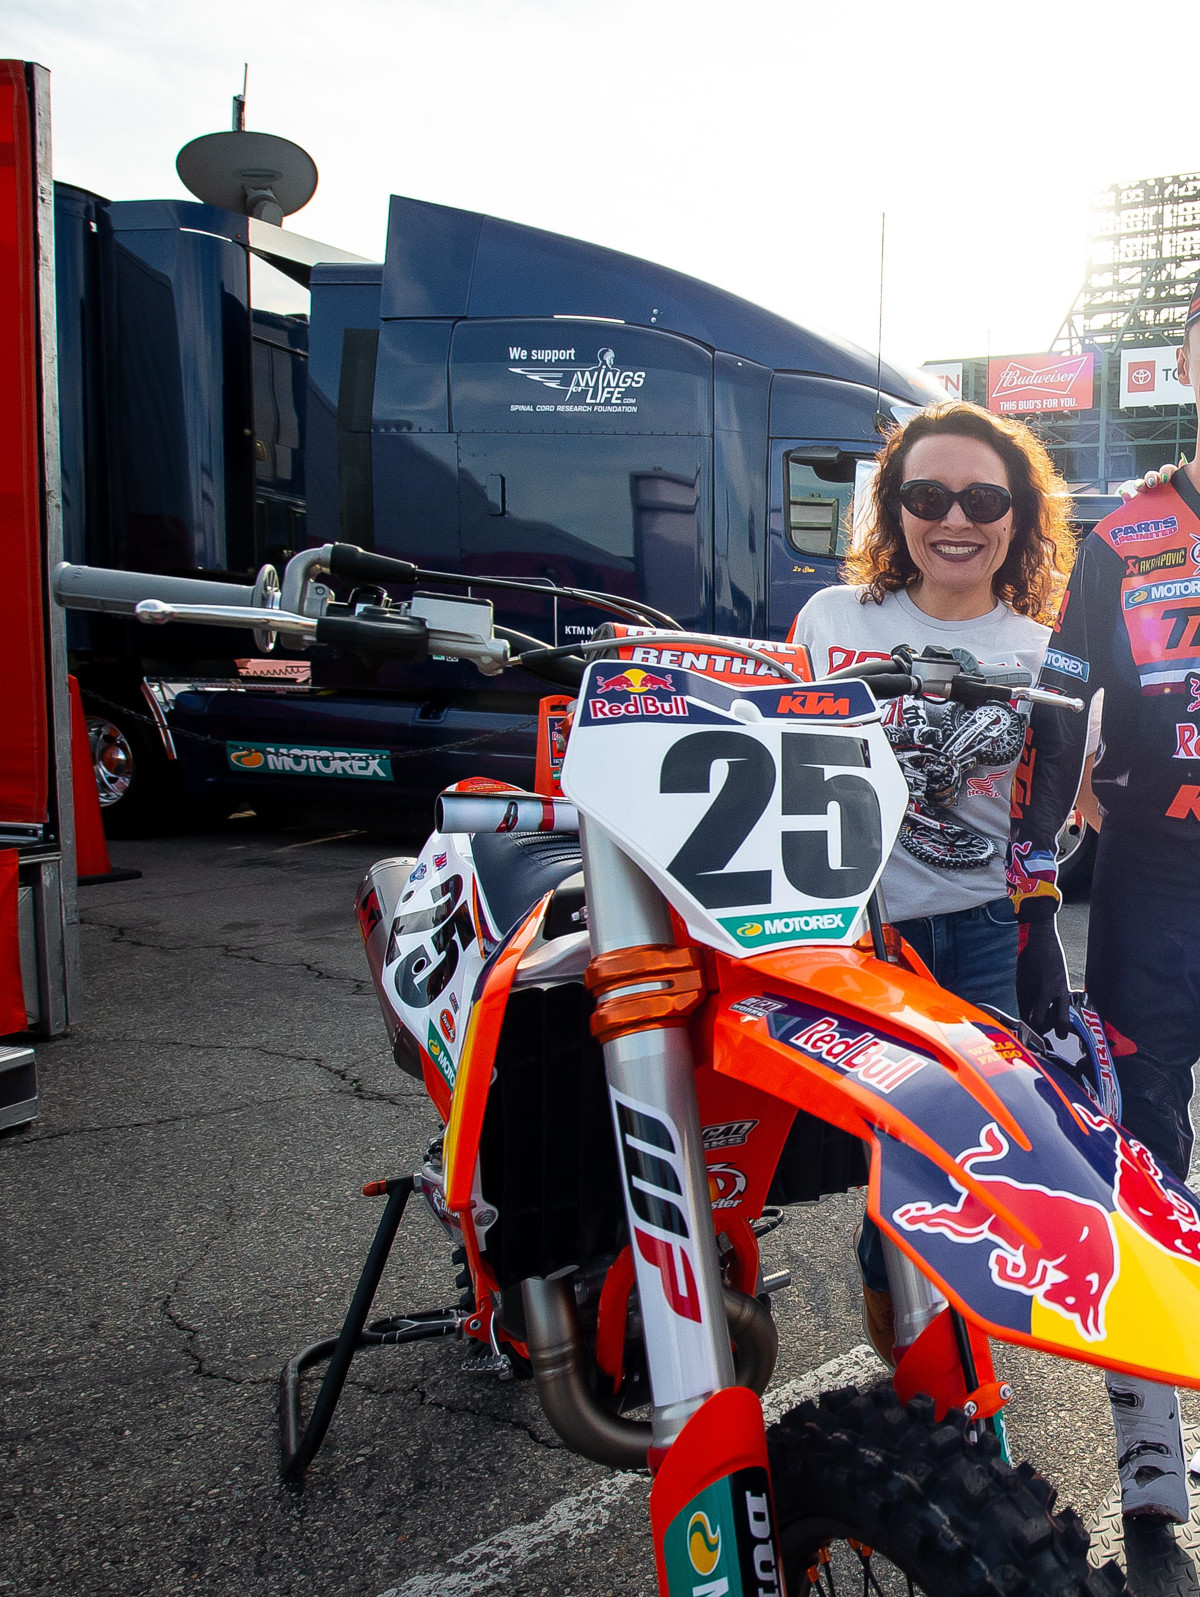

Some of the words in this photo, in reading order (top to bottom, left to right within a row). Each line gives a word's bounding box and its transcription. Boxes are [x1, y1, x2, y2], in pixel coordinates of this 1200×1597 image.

[509, 347, 527, 360] We
[531, 347, 575, 362] support
[575, 366, 646, 388] WINGS
[1000, 370, 1078, 388] Budweiser
[594, 405, 638, 413] FOUNDATION
[1000, 401, 1017, 411] THIS
[1018, 399, 1041, 410] BUD'S
[1043, 398, 1058, 409] FOR
[1059, 397, 1079, 408] YOU.
[1110, 516, 1177, 540] PARTS
[1114, 527, 1178, 546] UNLIMITED
[565, 625, 587, 635] KTM
[1049, 655, 1086, 678] TOREX
[590, 697, 640, 719] Red
[643, 695, 689, 717] Bull
[776, 690, 850, 716] KTM
[267, 747, 388, 777] MOTOREX
[659, 730, 883, 910] 25
[764, 912, 846, 936] MOTOREX
[440, 1012, 451, 1031] Twin
[792, 1018, 873, 1061] Red
[840, 1039, 926, 1092] Bull
[970, 1041, 1016, 1056] WELLS
[437, 1050, 456, 1088] MOTO
[702, 1121, 754, 1140] CAL
